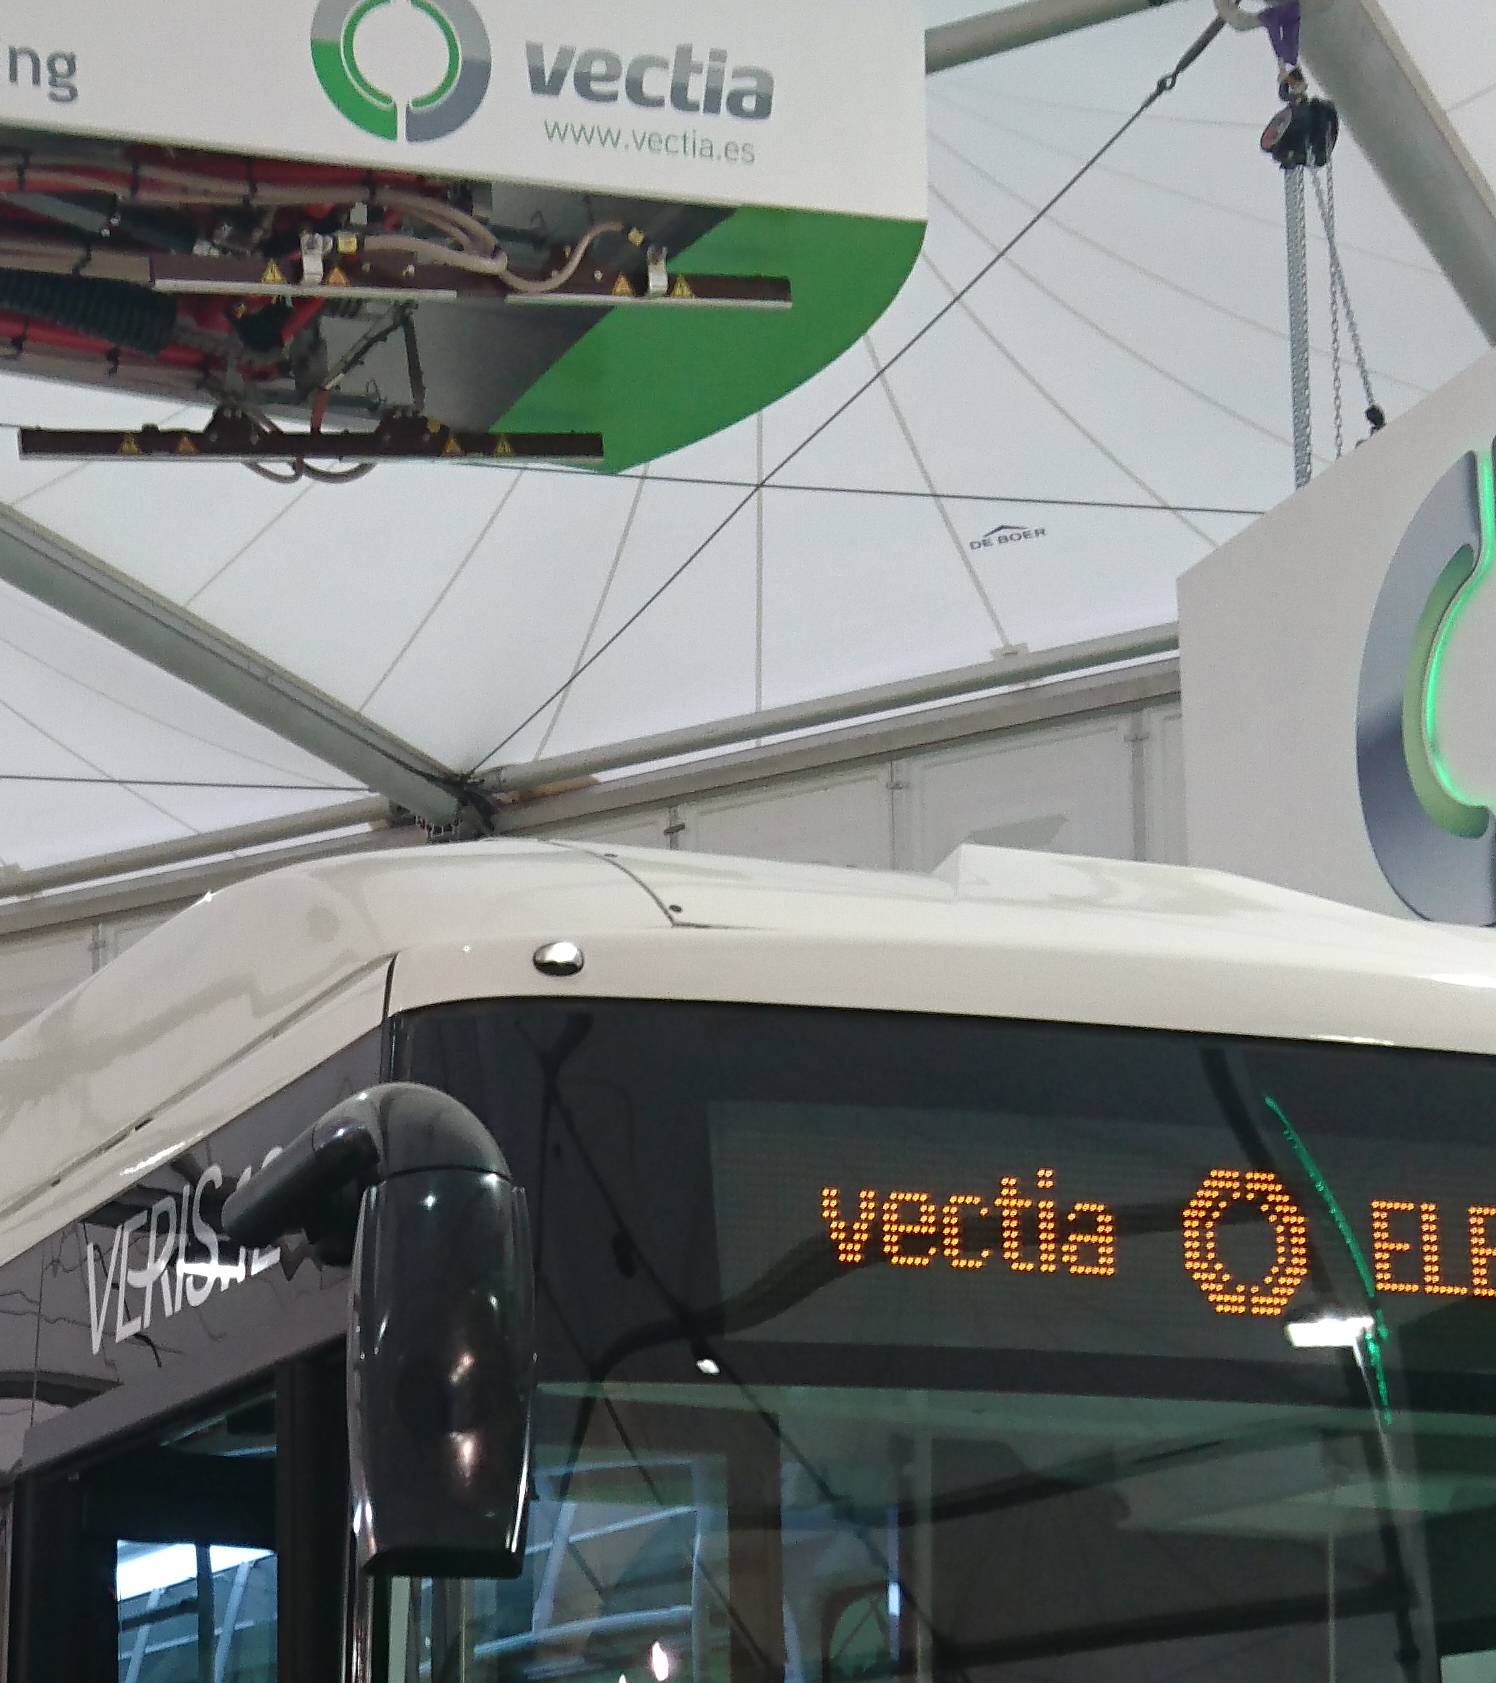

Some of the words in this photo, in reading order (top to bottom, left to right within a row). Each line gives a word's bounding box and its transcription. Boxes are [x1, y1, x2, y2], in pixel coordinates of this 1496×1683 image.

[524, 40, 776, 120] vectia
[543, 118, 756, 165] www.vectia.es
[819, 1168, 1118, 1278] vectia
